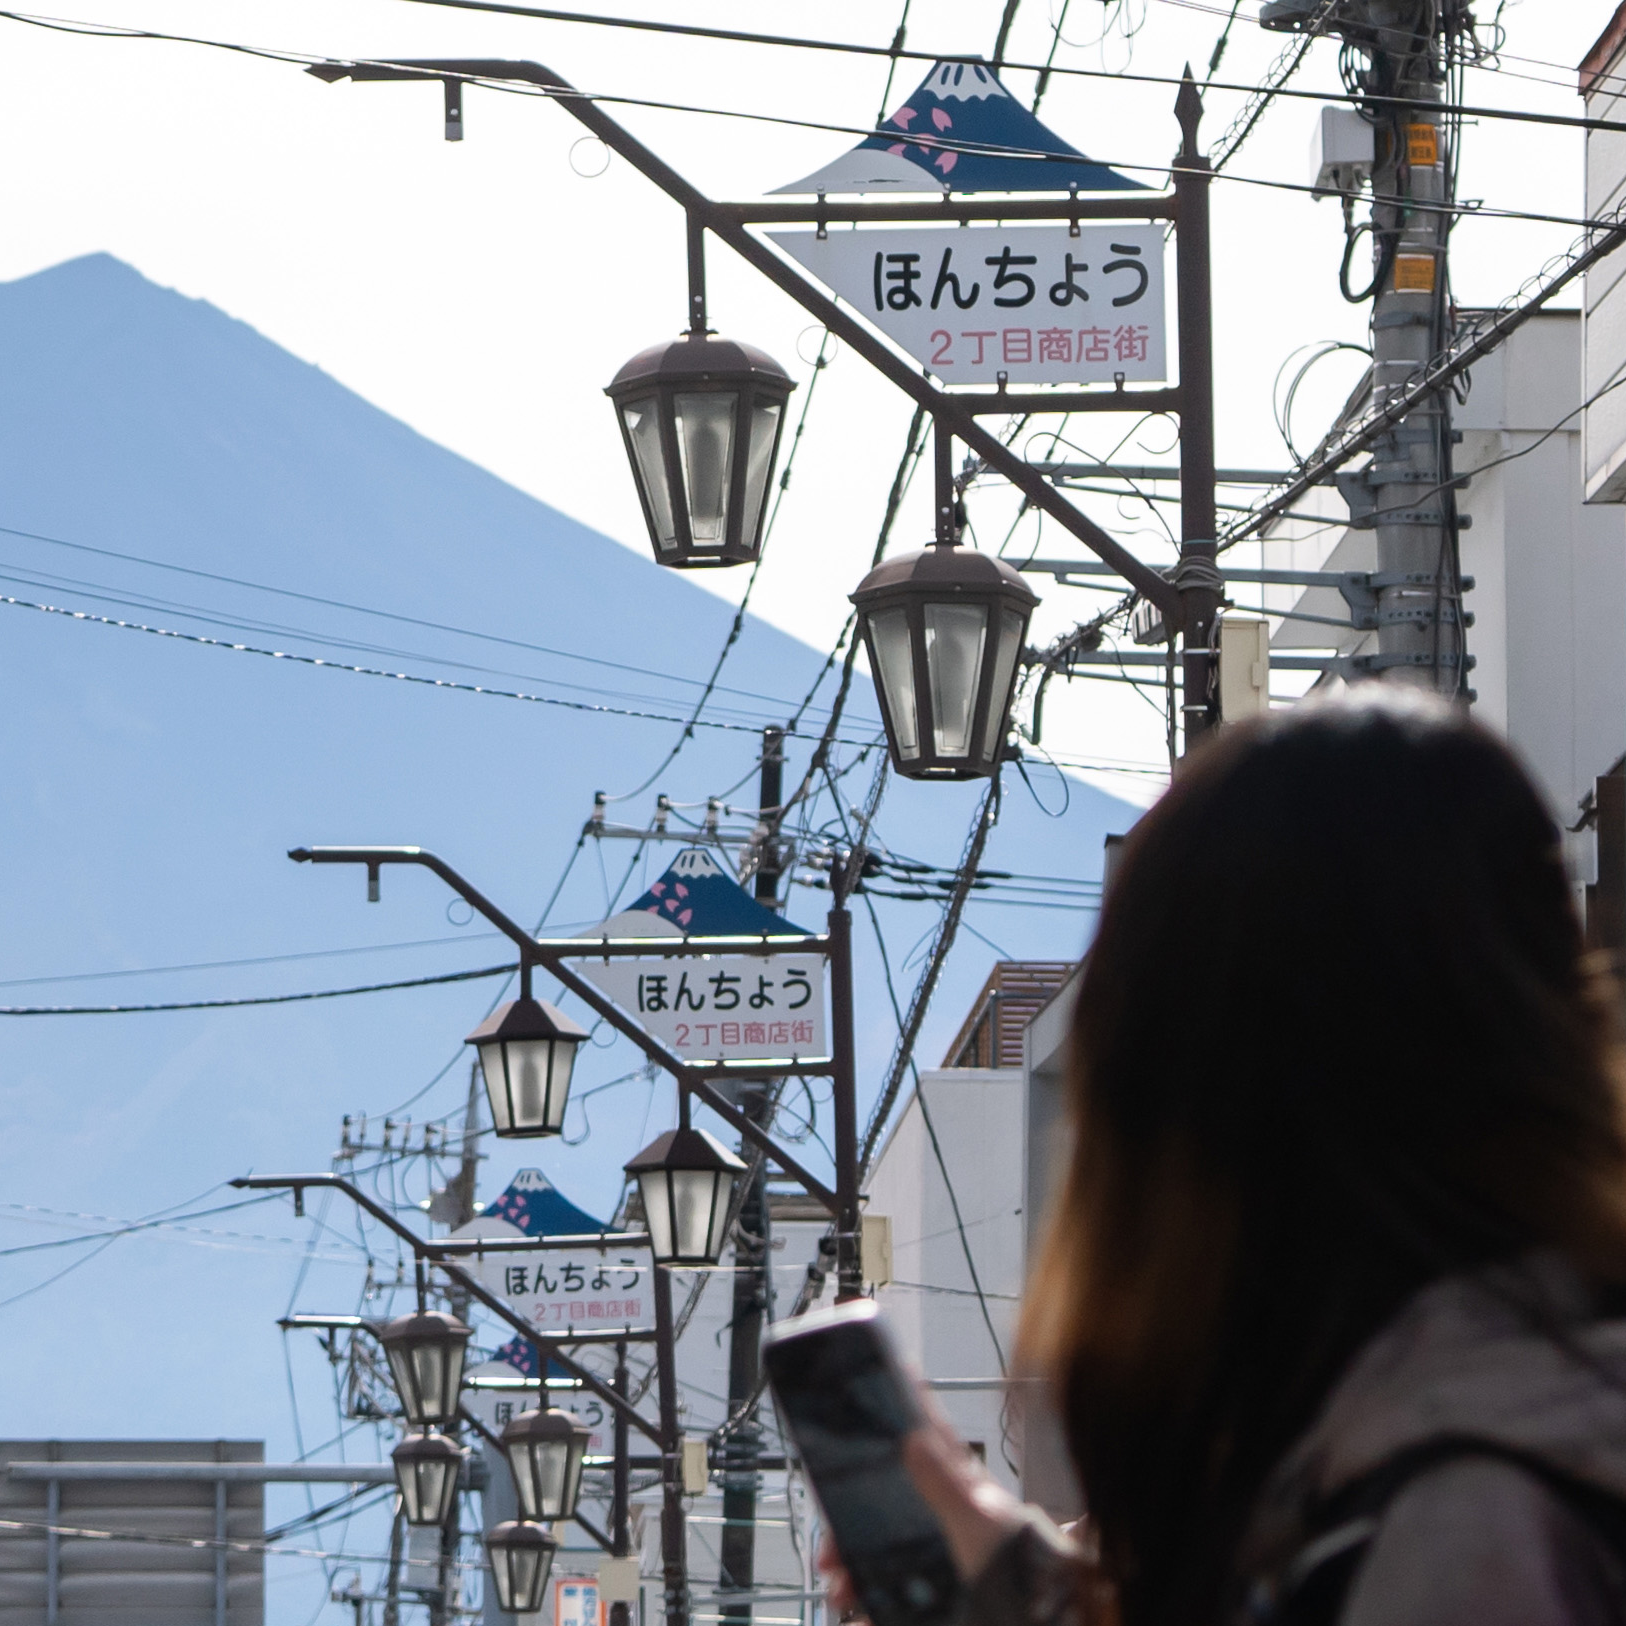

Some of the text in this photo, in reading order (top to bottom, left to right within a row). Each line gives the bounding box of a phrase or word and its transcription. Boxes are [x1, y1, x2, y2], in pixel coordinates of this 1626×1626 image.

[873, 243, 1151, 313] ほんちょう
[929, 324, 1149, 367] 2丁目商店街
[637, 967, 814, 1013] ほんちょう
[675, 1019, 815, 1048] 2丁目商店街
[505, 1258, 640, 1296] ほんちょう
[534, 1298, 641, 1321] 2丁目商店街
